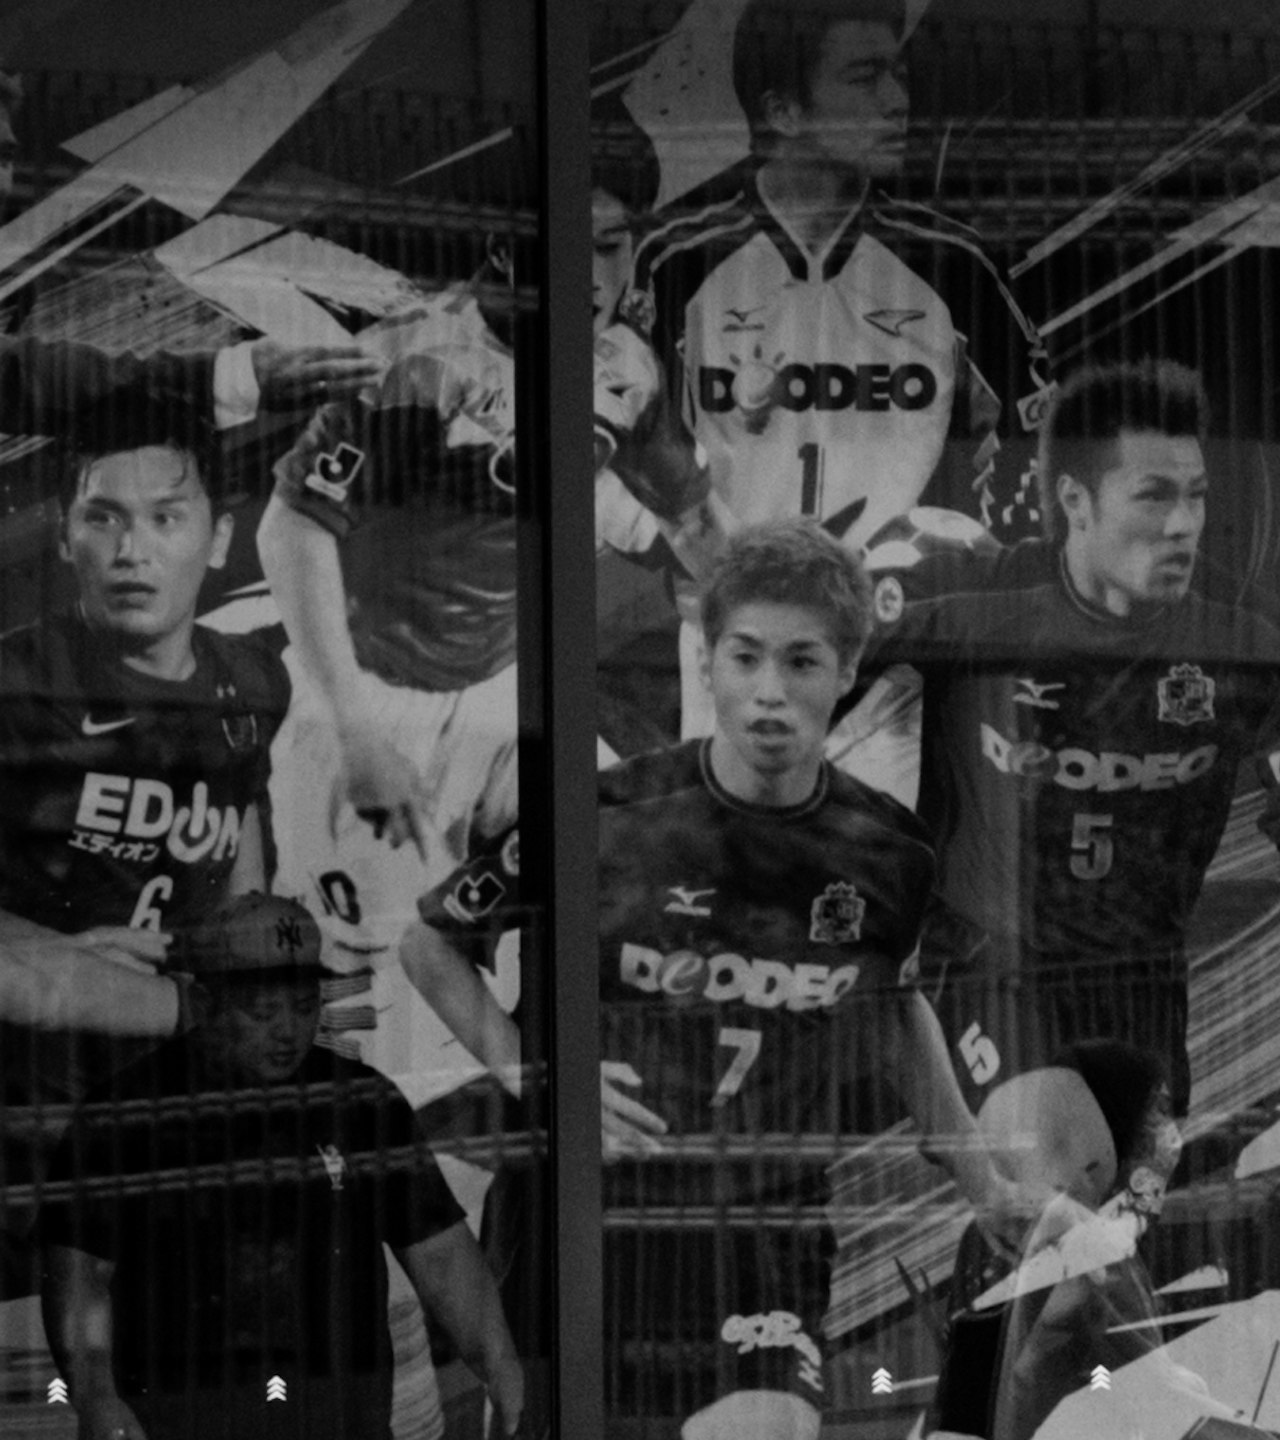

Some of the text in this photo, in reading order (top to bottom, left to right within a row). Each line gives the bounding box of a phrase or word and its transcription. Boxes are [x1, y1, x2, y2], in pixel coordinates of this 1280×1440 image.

[1067, 812, 1115, 881] 5
[709, 1025, 764, 1108] 7
[957, 1019, 1001, 1087] 5
